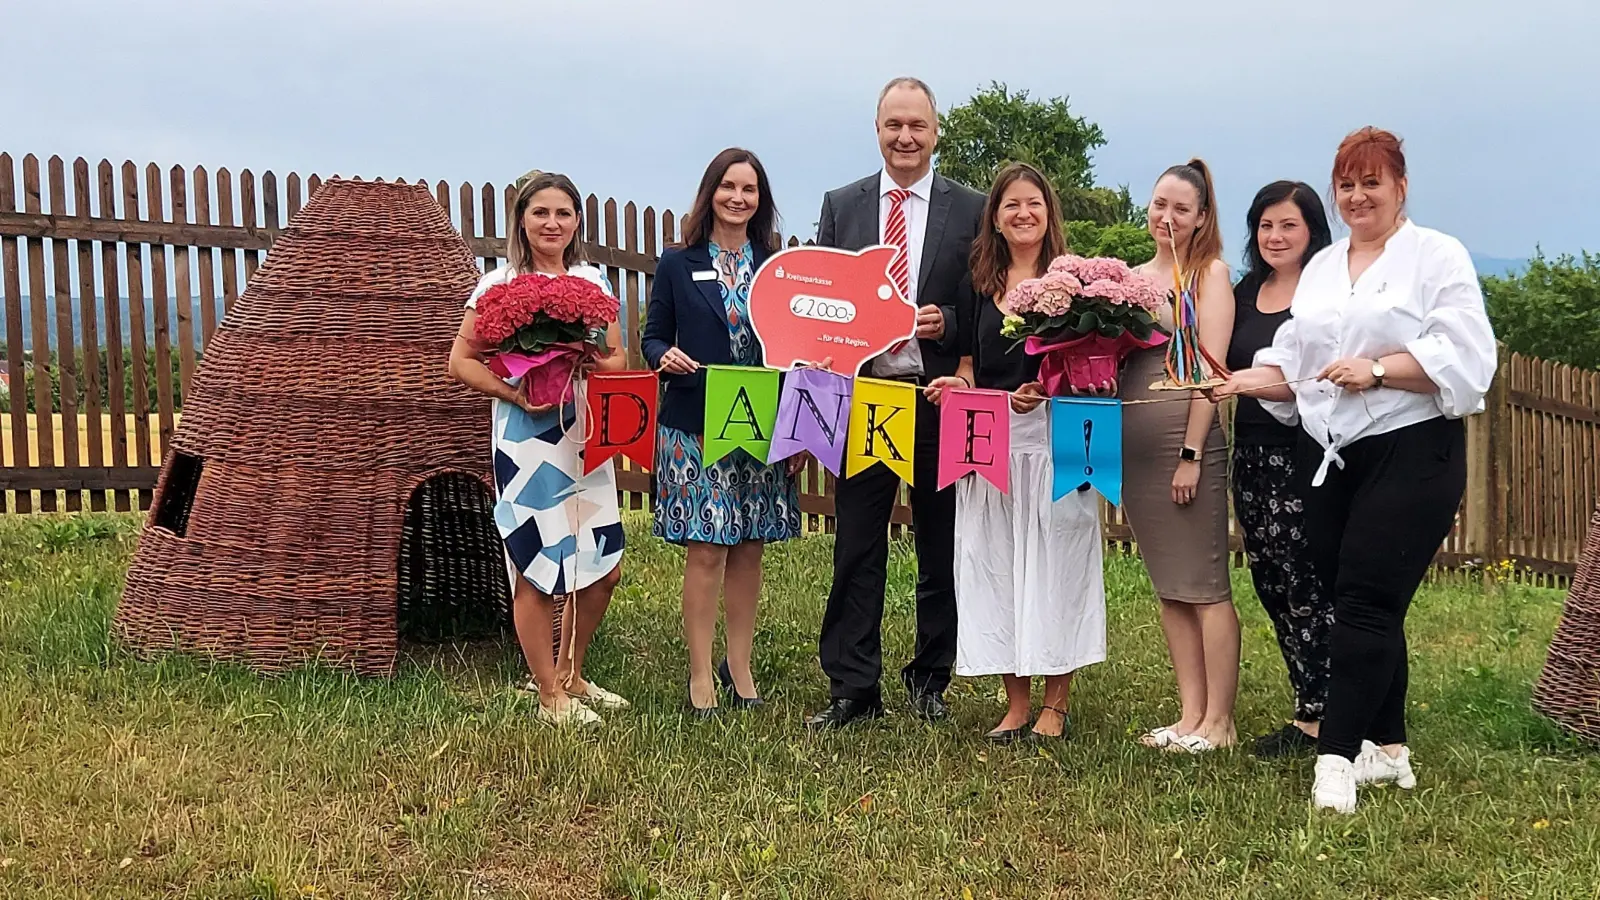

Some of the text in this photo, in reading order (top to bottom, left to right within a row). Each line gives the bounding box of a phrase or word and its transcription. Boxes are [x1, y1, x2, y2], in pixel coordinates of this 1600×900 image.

[786, 272, 833, 286] Kreissparkasse
[833, 335, 845, 344] die
[845, 336, 870, 348] Region.
